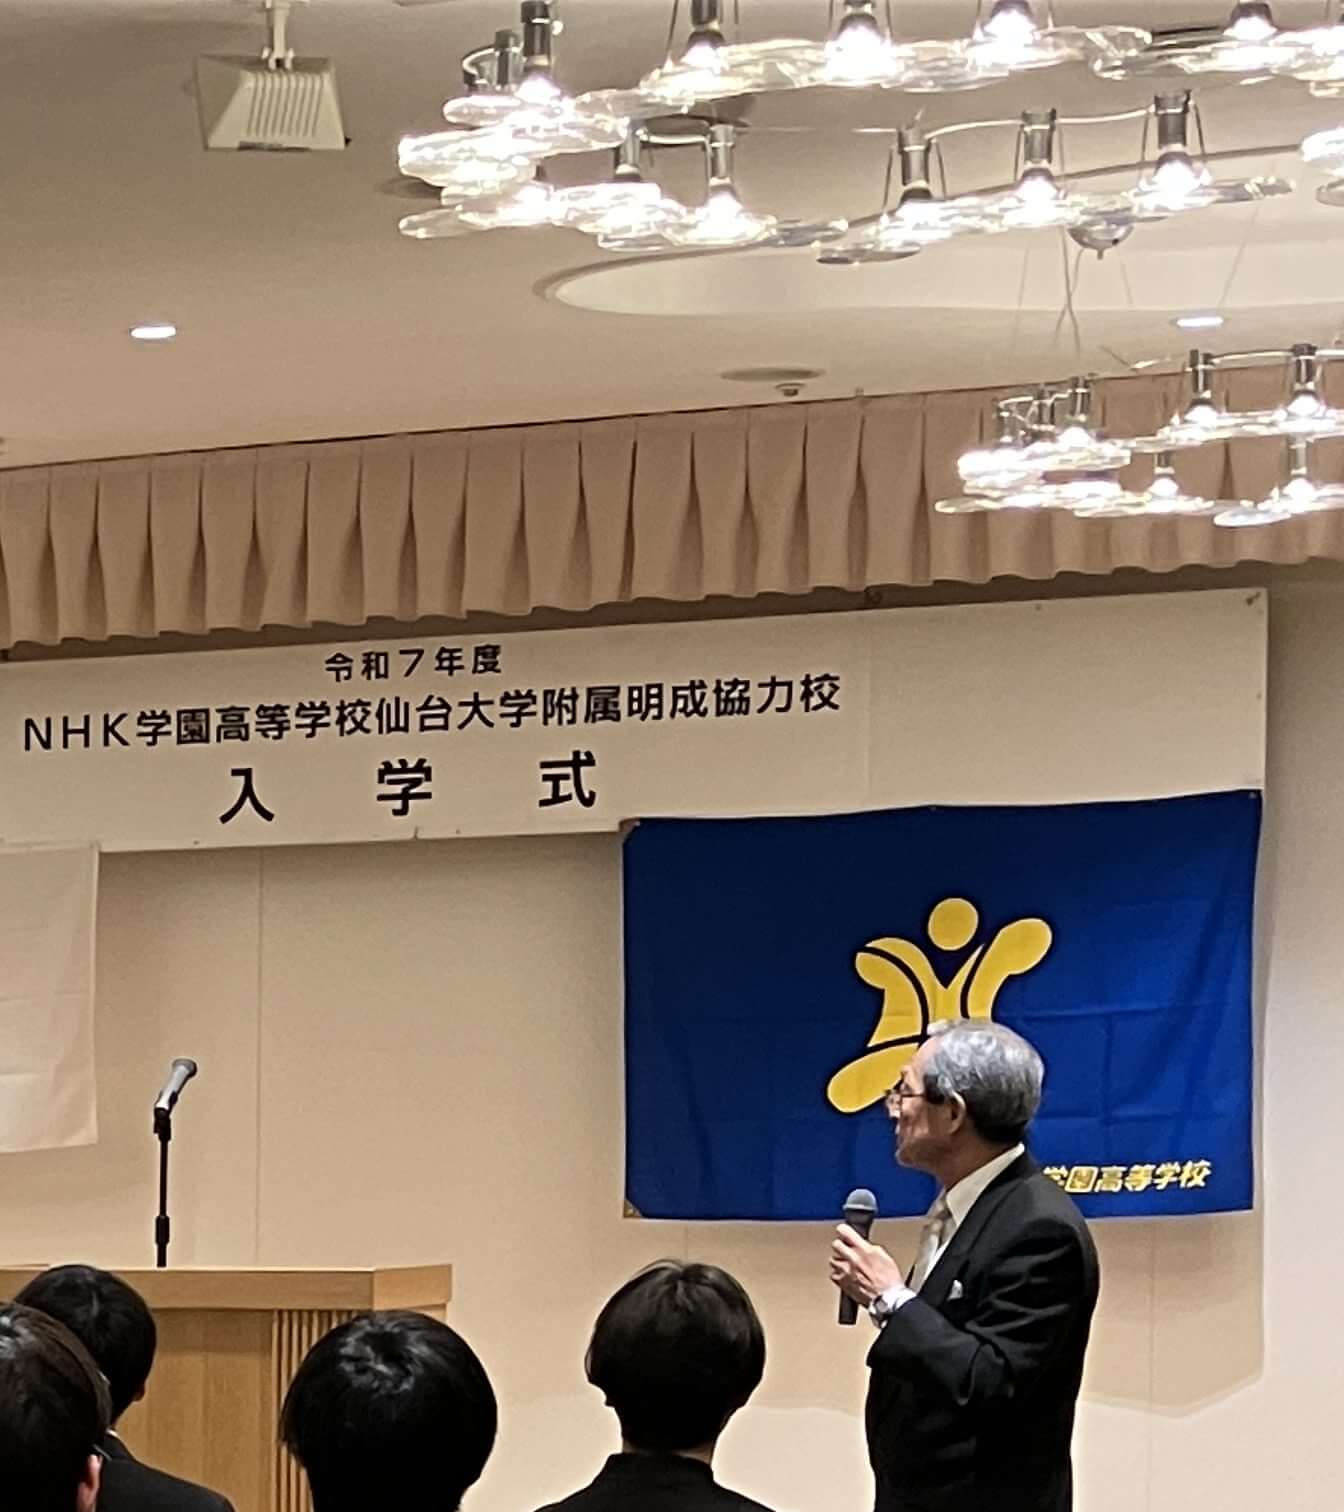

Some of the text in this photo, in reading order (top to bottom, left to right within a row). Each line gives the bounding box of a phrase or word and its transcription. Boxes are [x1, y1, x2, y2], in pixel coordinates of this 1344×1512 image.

[324, 644, 502, 683] 令和7年度
[23, 673, 841, 752] NHK学園高等学校仙台大学附属明成協力校
